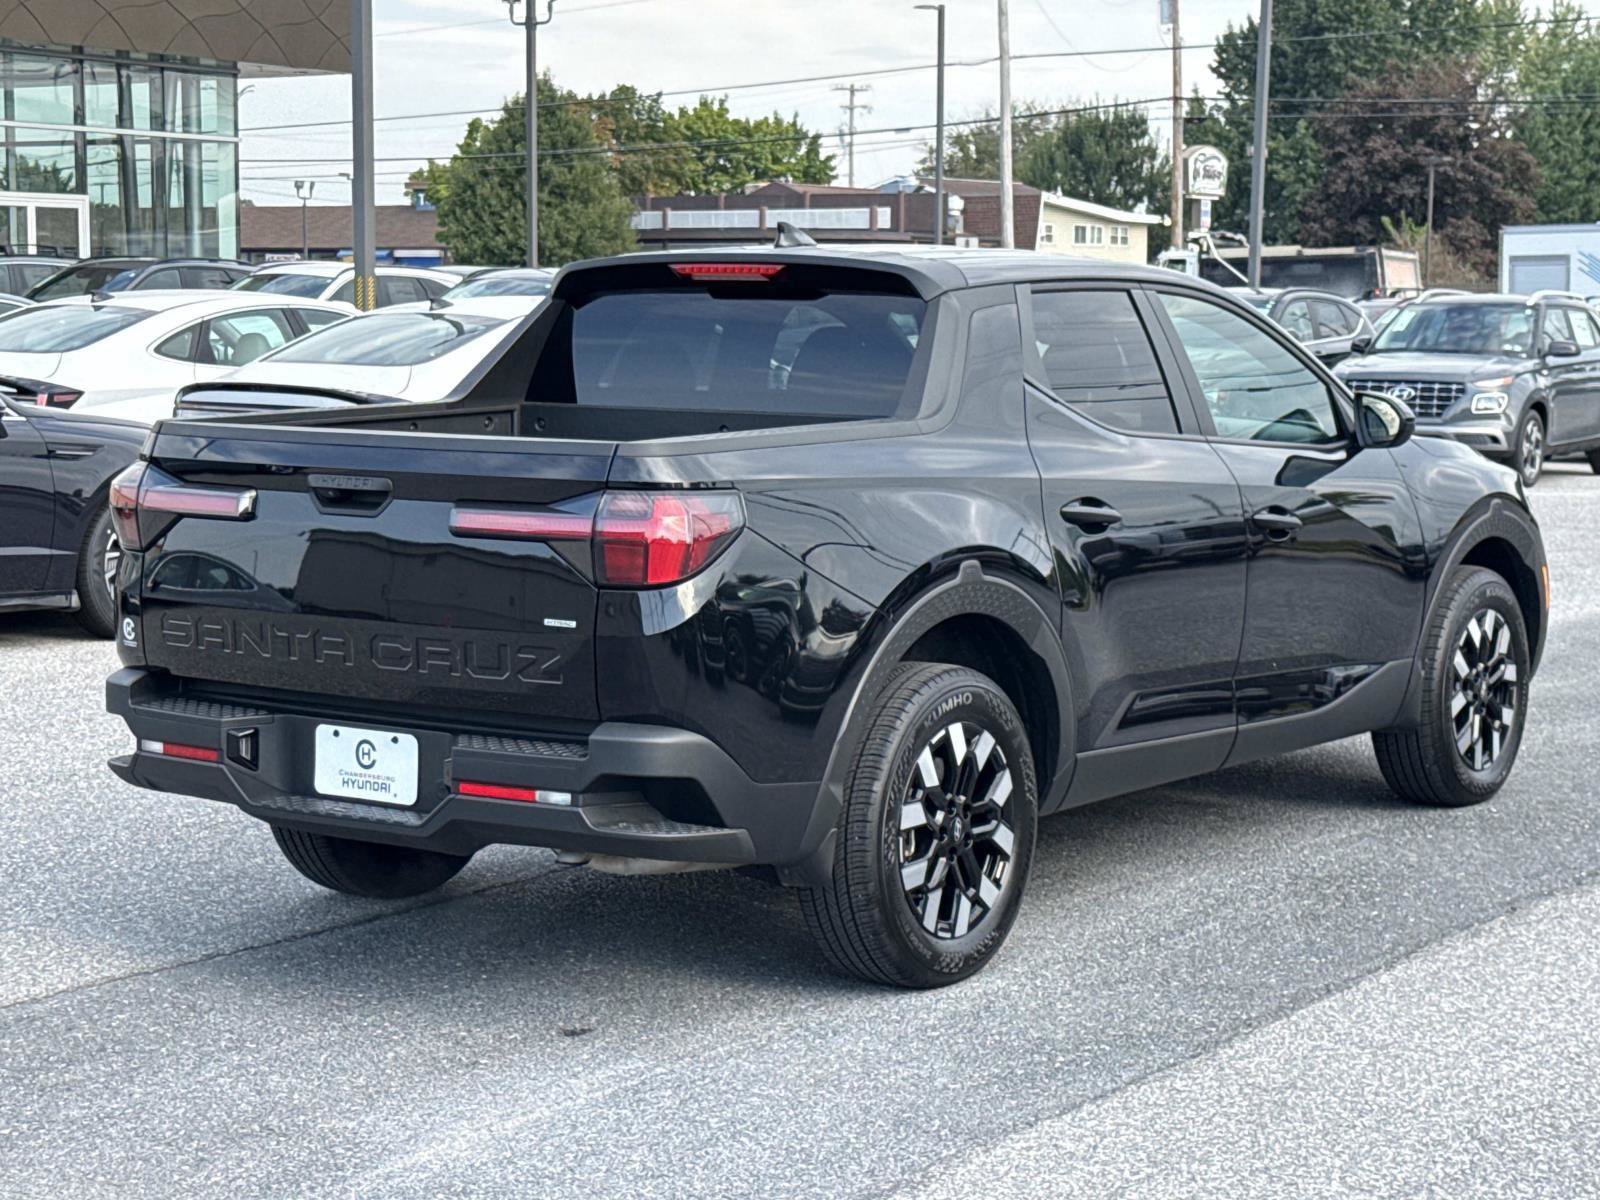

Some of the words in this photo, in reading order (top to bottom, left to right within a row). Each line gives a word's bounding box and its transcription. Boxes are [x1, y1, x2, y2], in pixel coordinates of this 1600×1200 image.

[319, 474, 374, 490] HYUNDAI
[161, 612, 355, 667] SANTA
[370, 633, 563, 685] CRUZ
[924, 692, 973, 728] KUMHO
[341, 776, 391, 794] HYUNDAI
